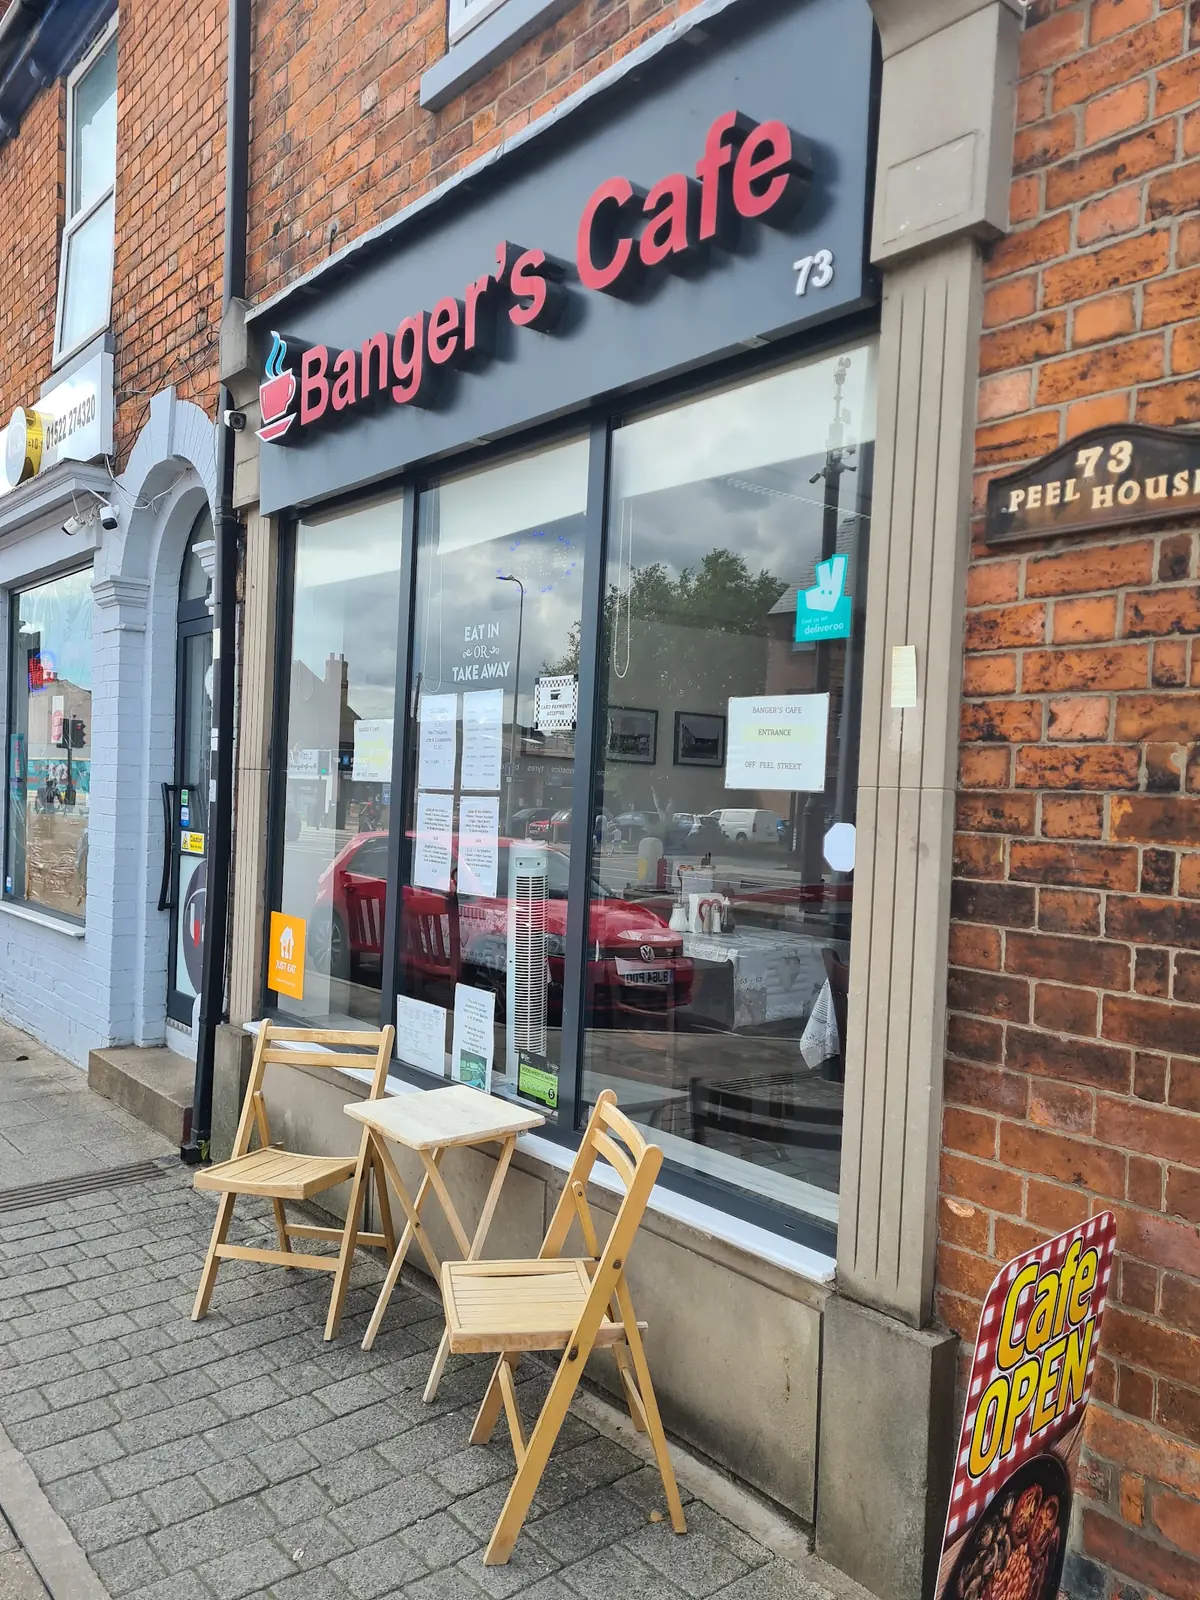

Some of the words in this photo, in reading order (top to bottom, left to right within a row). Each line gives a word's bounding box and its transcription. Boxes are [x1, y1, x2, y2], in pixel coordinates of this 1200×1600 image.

[300, 241, 546, 426] Banger's
[577, 110, 792, 291] Cafe
[793, 249, 834, 296] 73
[46, 414, 67, 450] 01522
[68, 394, 96, 436] 274320
[1075, 440, 1133, 478] 73
[1008, 478, 1080, 512] PEEL
[1091, 468, 1200, 509] HOUS
[464, 624, 485, 642] EAT
[487, 622, 499, 639] IN
[804, 622, 844, 635] deliveroo
[473, 645, 490, 659] OR
[452, 664, 479, 682] TAKE
[480, 661, 510, 679] AWAY
[752, 706, 783, 714] BANGER'S
[785, 706, 802, 714] CAFE
[758, 728, 791, 736] ENTRANCE
[744, 760, 756, 768] OFF
[760, 761, 774, 769] PEEL
[777, 762, 802, 770] STREET
[275, 960, 288, 970] JUST
[287, 963, 297, 974] EAT
[996, 1237, 1098, 1372] Cafe
[968, 1317, 1095, 1478] OPEN
